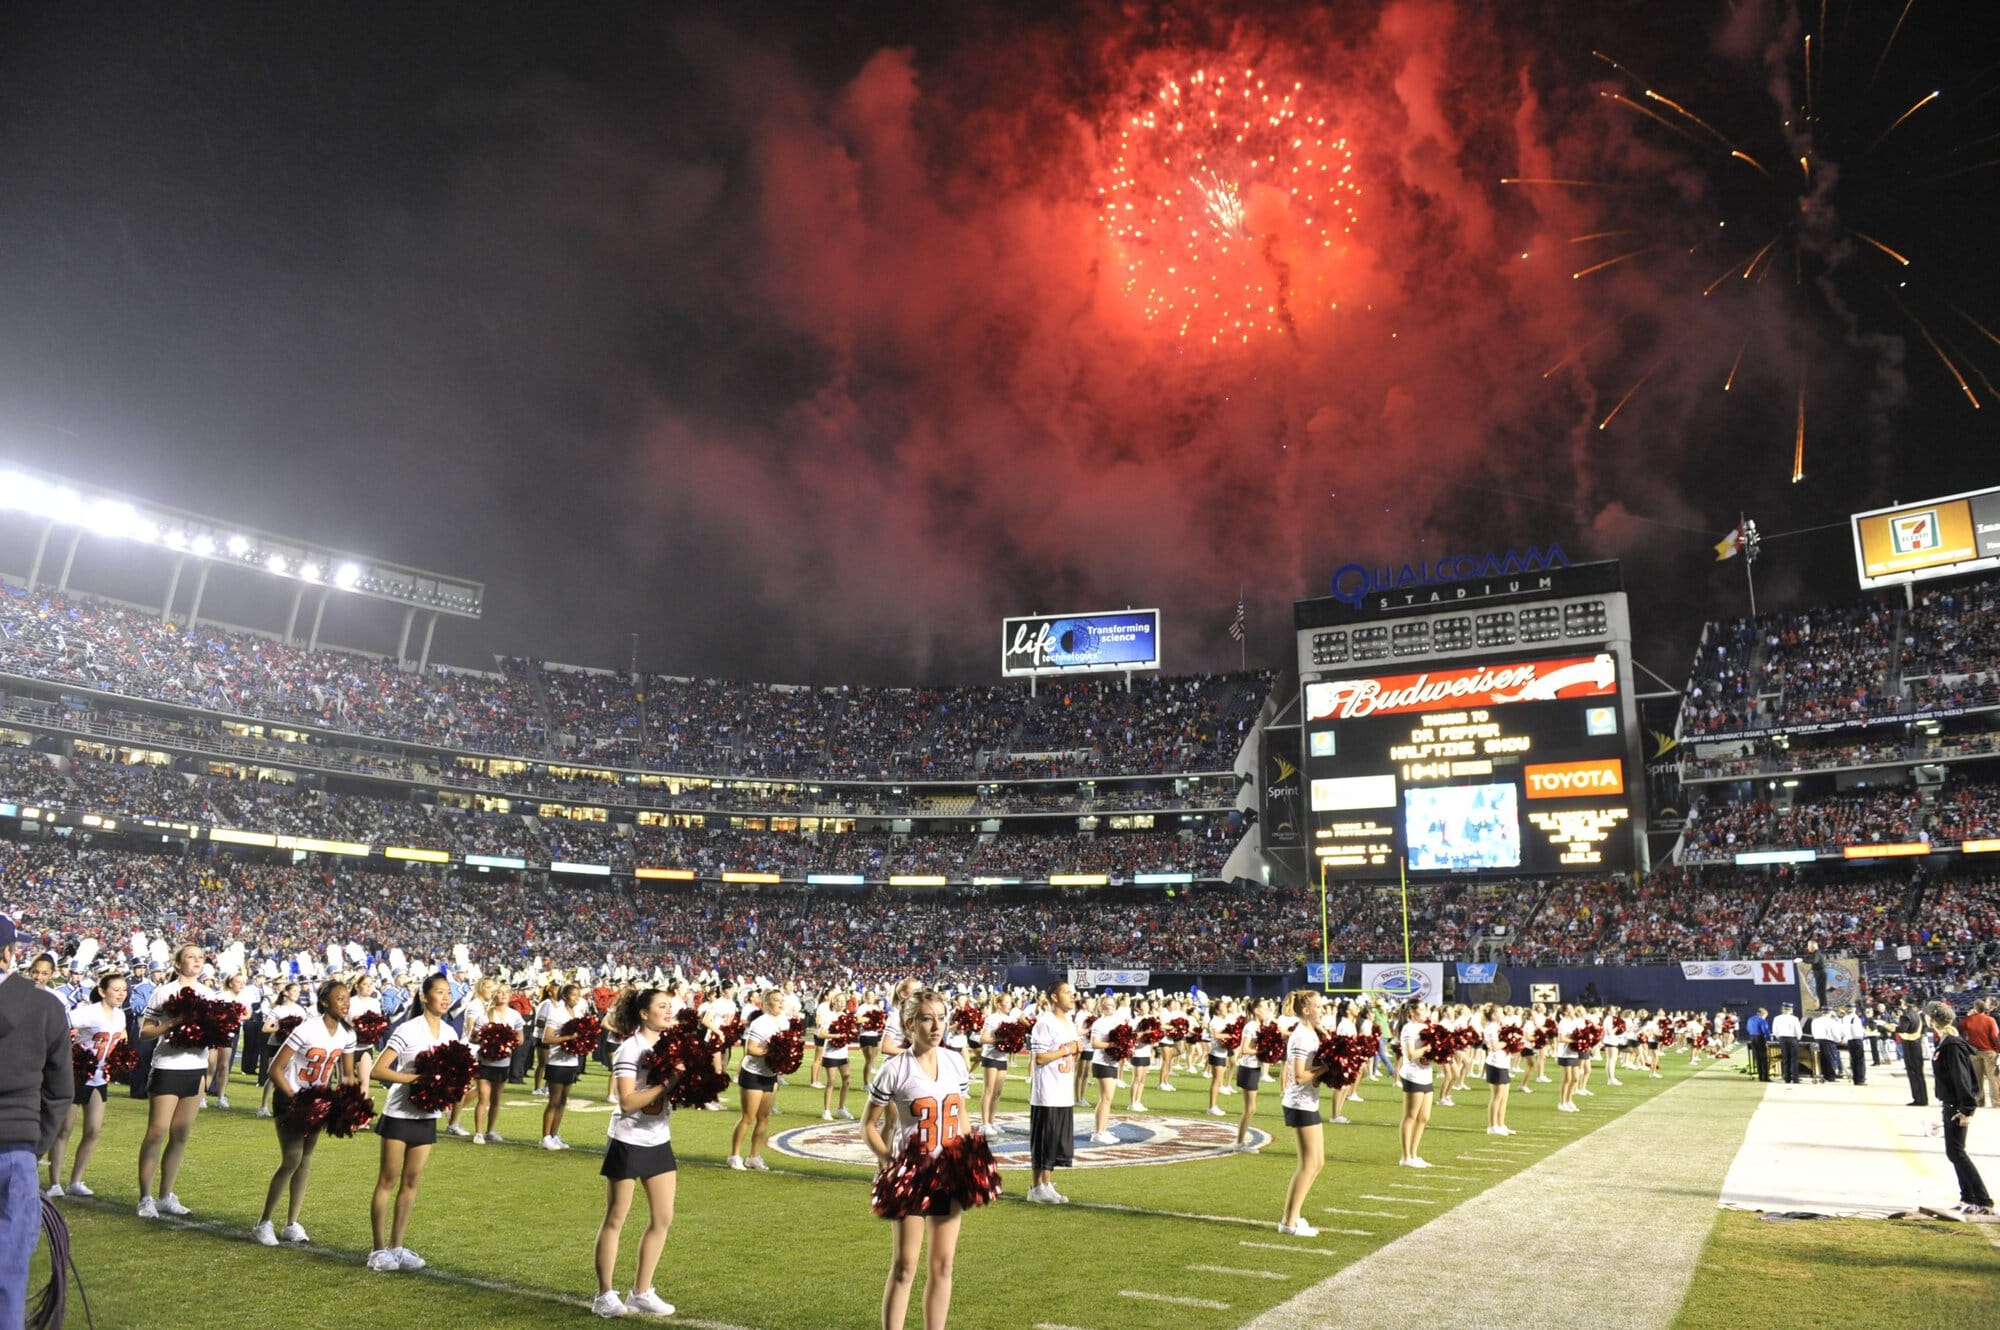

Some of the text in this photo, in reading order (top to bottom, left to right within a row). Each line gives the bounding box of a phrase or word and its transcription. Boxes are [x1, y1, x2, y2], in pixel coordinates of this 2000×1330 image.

[1331, 543, 1569, 609] QUALCOMM
[1380, 577, 1552, 608] STADIUM
[1087, 623, 1150, 635] Transforming
[1101, 633, 1136, 643] science
[1007, 622, 1057, 666] life
[1336, 664, 1536, 719] Budweiser
[1411, 723, 1500, 743] DR PEPPER
[1645, 761, 1681, 777] Sprin
[1529, 769, 1618, 791] TOYOTA
[1268, 785, 1299, 799] Sprint
[1075, 971, 1090, 987] A
[1761, 962, 1786, 983] N
[910, 1093, 961, 1153] 36
